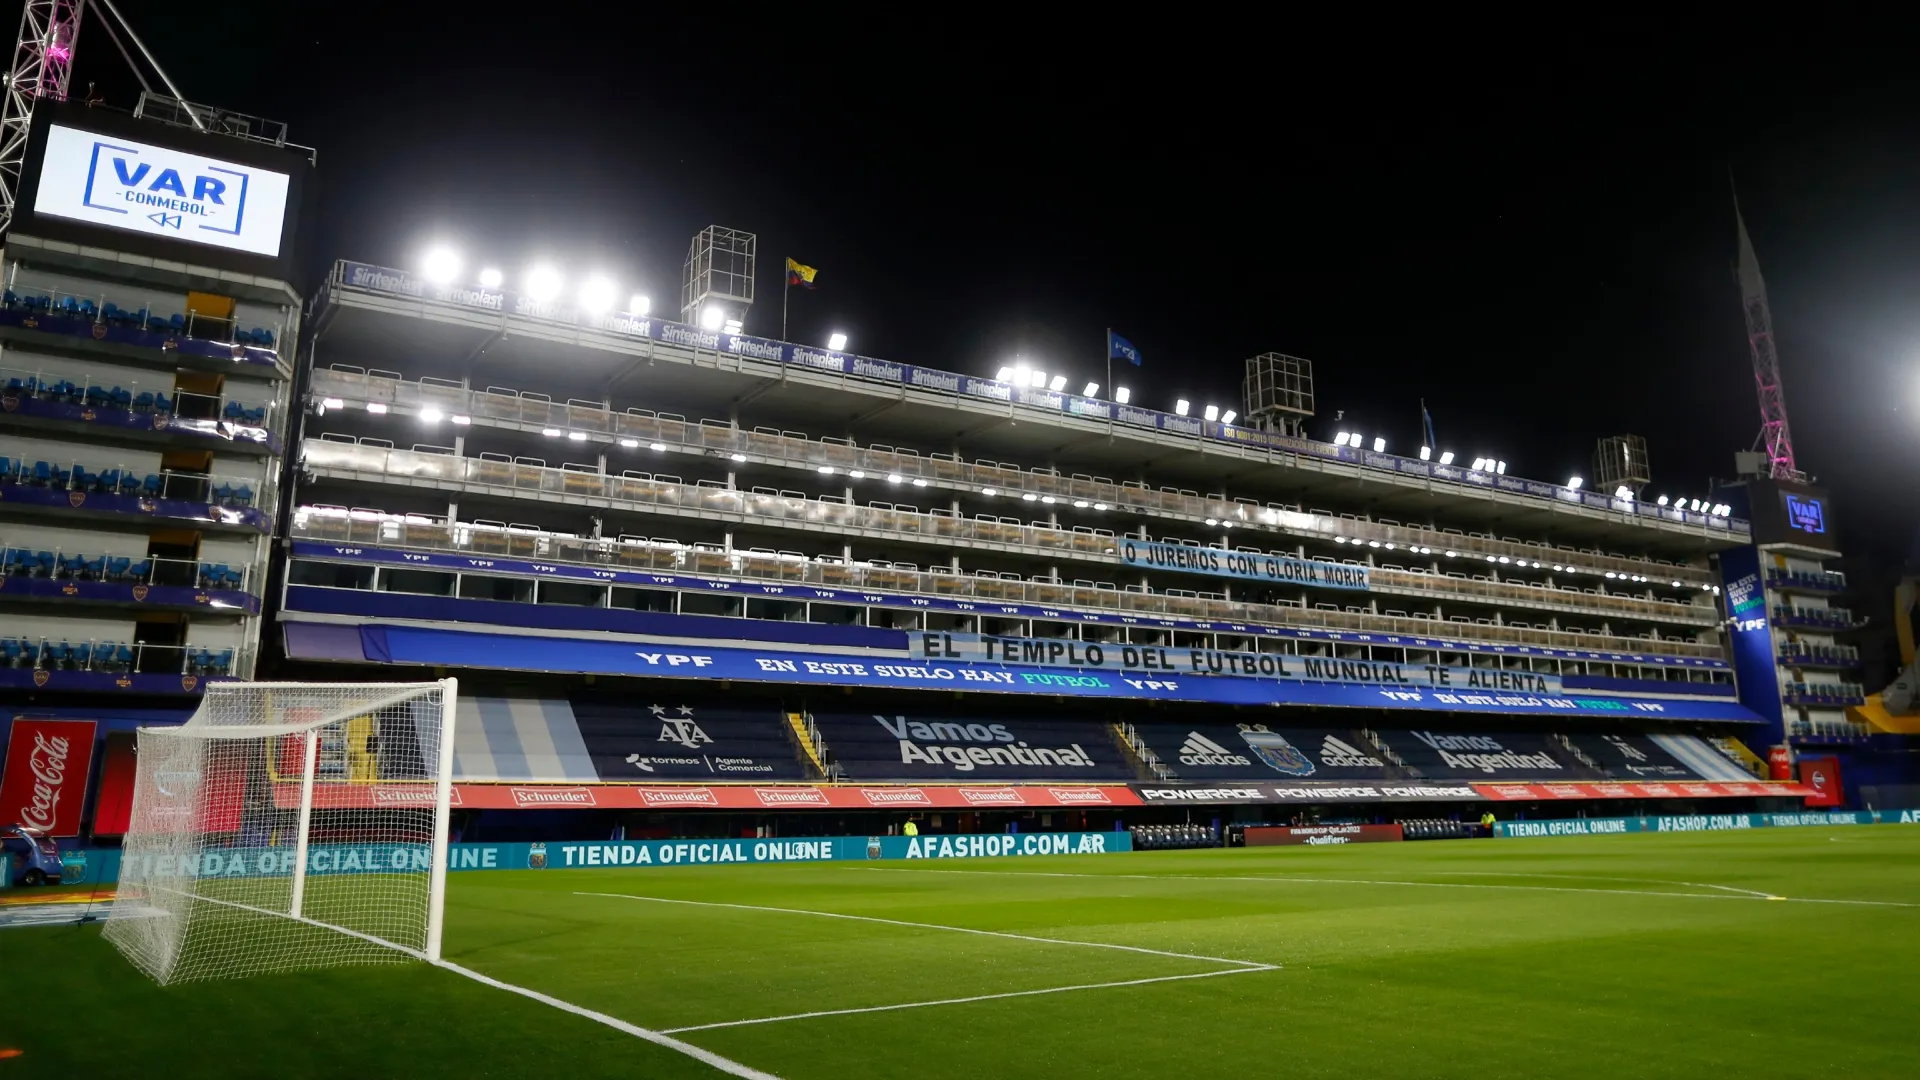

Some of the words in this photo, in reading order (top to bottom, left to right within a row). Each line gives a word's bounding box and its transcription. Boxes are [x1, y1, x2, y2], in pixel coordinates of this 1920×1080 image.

[113, 157, 226, 205] VAR
[125, 190, 208, 217] CONMEBOL
[662, 325, 719, 346] Sinteplast
[729, 337, 783, 360] Sinteplast
[792, 348, 844, 370] Sinteplast
[853, 359, 902, 380] Sinteplast
[912, 369, 958, 390] Sinteplast
[966, 380, 1011, 400] Sinteplast
[1224, 427, 1235, 438] ISO
[335, 547, 362, 555] YPF
[403, 553, 430, 562] YPF
[469, 559, 494, 568] YPF
[532, 565, 557, 573] YPF
[593, 570, 617, 579] YPF
[652, 576, 674, 584] YPF
[815, 590, 835, 598] YPF
[1126, 542, 1136, 563] O
[1146, 546, 1219, 572] JUREMOS
[1227, 554, 1258, 576] CON
[1266, 559, 1318, 582] GLORIA
[1324, 566, 1366, 588] MORIR
[1735, 618, 1766, 632] YPF
[635, 652, 713, 667] YPF
[755, 658, 798, 672] EN
[803, 660, 869, 676] ESTE
[873, 665, 955, 680] SUELO
[958, 669, 1016, 684] HAY
[1020, 672, 1110, 688] FUTBOL
[1123, 678, 1179, 692] YPF
[923, 633, 961, 658] EL
[981, 636, 1104, 666] TEMPLO
[1123, 647, 1175, 670] DEL
[1190, 651, 1291, 676] FUTBOL
[1304, 658, 1408, 683] MUNDIAL
[1424, 666, 1450, 685] TE
[1467, 670, 1549, 694] ALIENTA
[1380, 691, 1422, 701] YPF
[657, 715, 714, 749] AFA
[873, 715, 1014, 742] Vamos
[1410, 730, 1503, 750] Vamos
[651, 756, 700, 765] torneos
[715, 756, 753, 766] Agente
[900, 740, 1095, 771] Argentina!
[1179, 753, 1251, 766] adidas
[1321, 755, 1384, 767] adidas
[1437, 749, 1562, 773] Argentina!
[718, 764, 773, 772] Comercial
[21, 730, 70, 831] Coca-Cola
[377, 790, 454, 801] Schneid
[519, 791, 587, 802] Schneider
[645, 791, 710, 802] Schneider
[760, 791, 821, 802] Schneider
[867, 791, 923, 802] Schneider
[964, 791, 1017, 801] Schneider
[1054, 791, 1103, 801] Schneider
[1141, 789, 1266, 800] POWERADE
[1274, 787, 1382, 798] POWERADE
[1382, 787, 1477, 797] POWERADE
[1658, 815, 1751, 832] AFASHOP.COM.AR
[1772, 815, 1800, 826] TIENDA
[1800, 813, 1829, 825] OFICIAL
[1507, 821, 1547, 837] TIENDA
[1549, 820, 1588, 836] OFICIAL
[1589, 820, 1626, 834] ONLINE
[906, 834, 1105, 859] AFASHOP.COM.AR
[1309, 835, 1344, 845] Qualifiers
[563, 845, 652, 865] TIENDA
[659, 843, 747, 863] OFICIAL
[754, 841, 832, 861] ONLINE
[120, 853, 246, 877] TIENDA
[258, 849, 381, 875] OFCIAL
[391, 848, 498, 870] ONINE
